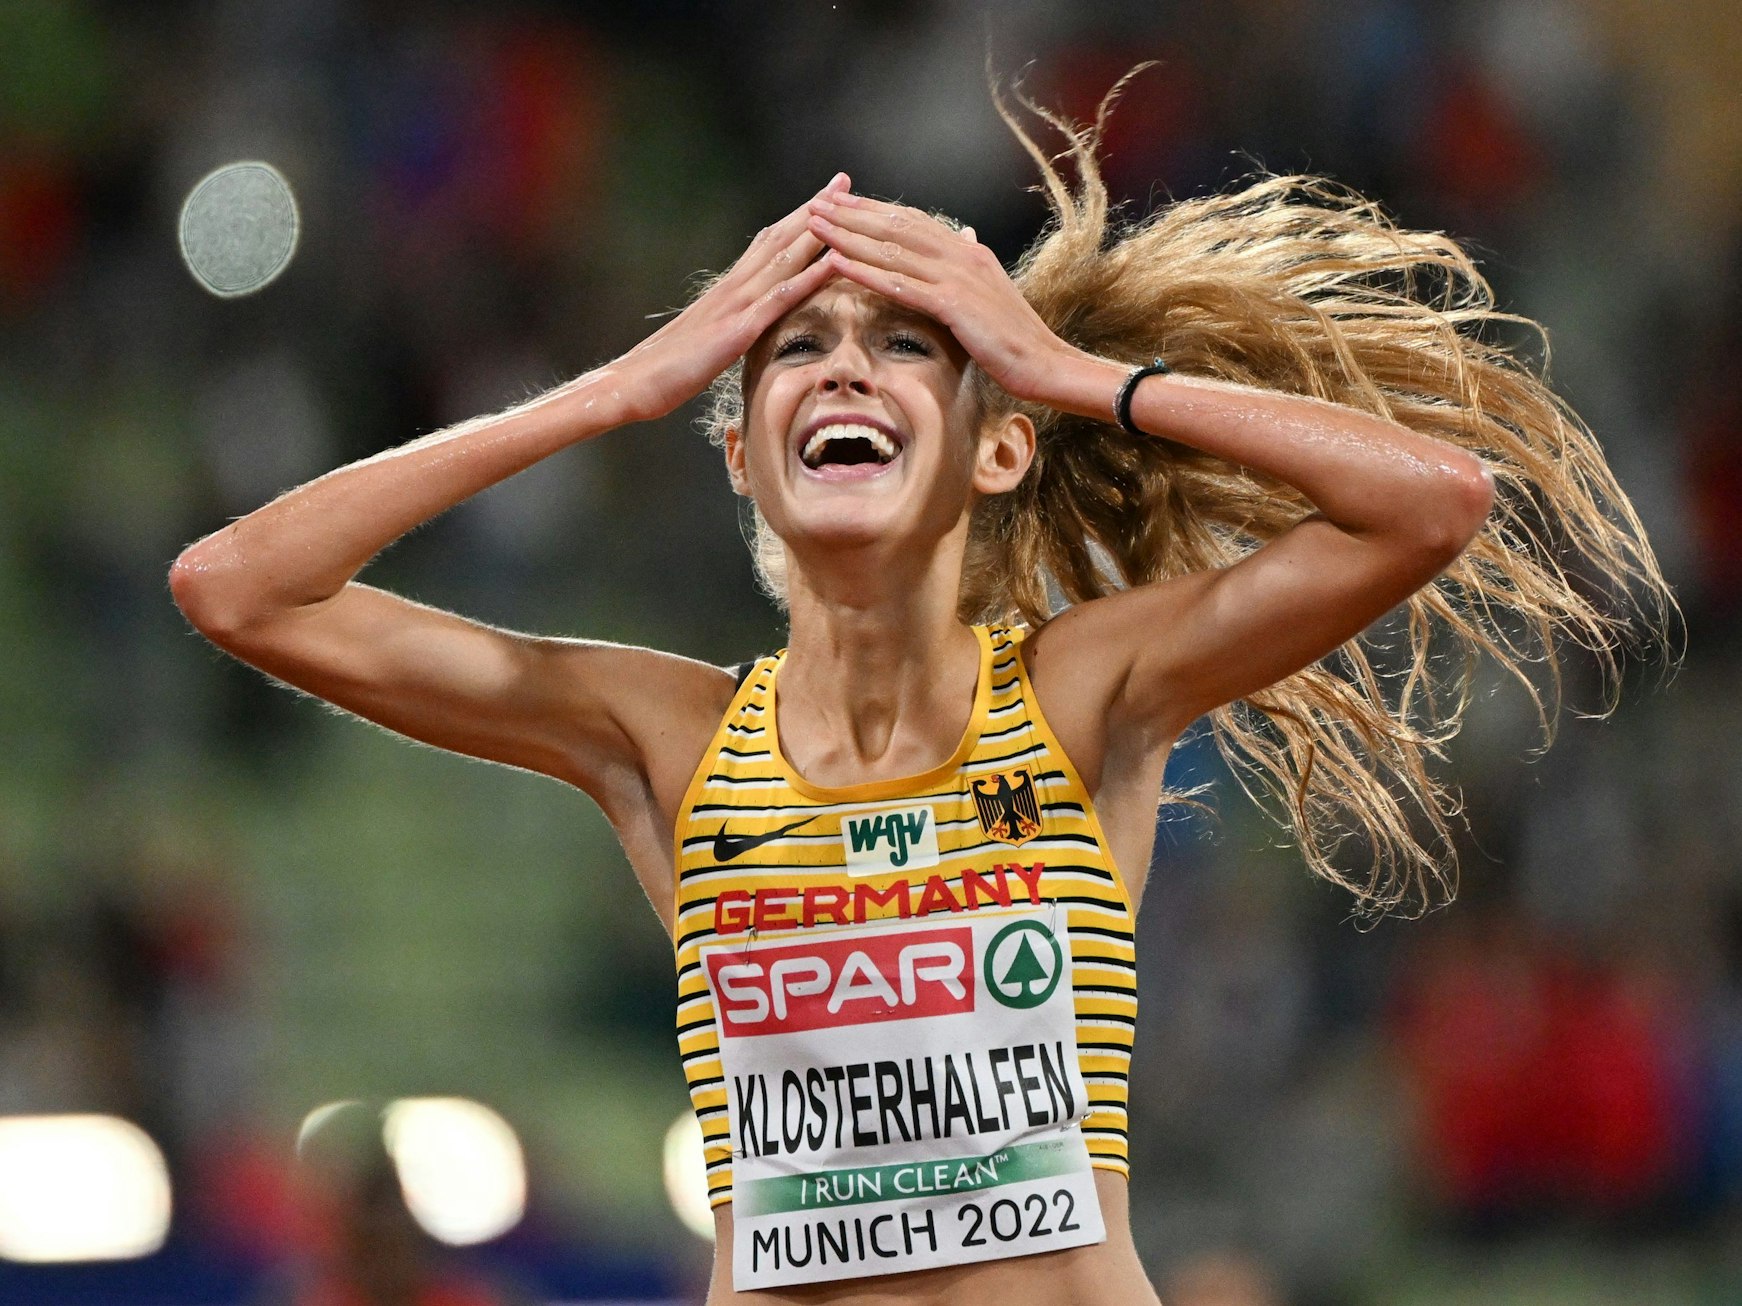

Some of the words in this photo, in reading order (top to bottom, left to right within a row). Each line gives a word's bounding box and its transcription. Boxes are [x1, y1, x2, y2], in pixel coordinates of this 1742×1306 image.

[715, 862, 1046, 935] GERMANY
[717, 941, 966, 1024] SPAR
[734, 1041, 1075, 1158] KLOSTERHALFEN
[800, 1178, 807, 1205] I
[815, 1171, 883, 1204] RUN
[752, 1208, 938, 1273] MUNICH
[957, 1189, 1080, 1247] 2022
